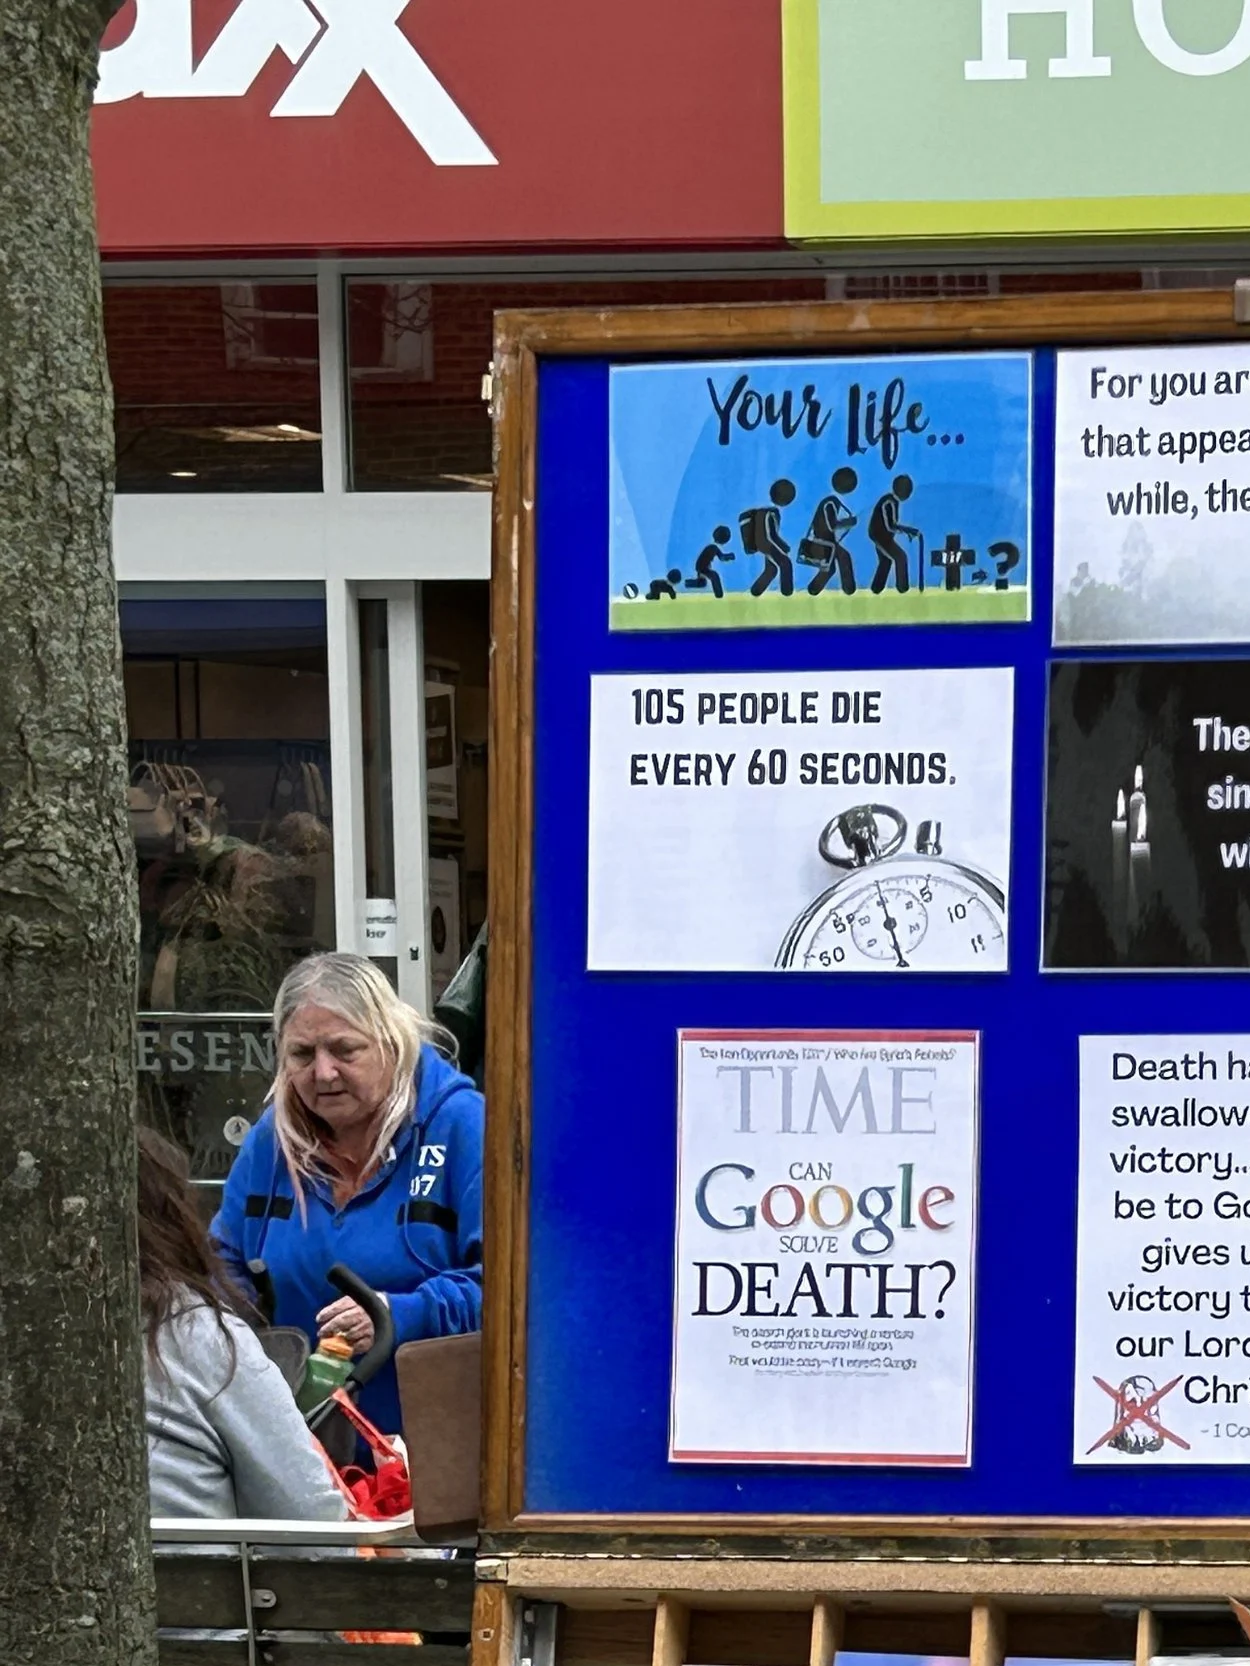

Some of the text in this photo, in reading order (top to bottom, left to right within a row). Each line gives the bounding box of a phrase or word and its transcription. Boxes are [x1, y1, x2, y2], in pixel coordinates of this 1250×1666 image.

[1090, 366, 1143, 399] For
[1150, 368, 1207, 406] you
[706, 373, 966, 470] Your Life...
[1081, 424, 1151, 458] that
[1107, 480, 1198, 519] while,
[632, 688, 882, 726] 105 PEOPLE DIE
[1193, 716, 1250, 752] The
[630, 748, 957, 786] EVERY 60 SECONDS.
[947, 903, 967, 923] 10
[137, 1030, 275, 1073] ESEN
[1112, 1050, 1217, 1081] Death
[715, 1065, 937, 1135] TIME
[788, 1162, 833, 1181] CAN
[694, 1162, 956, 1256] Google
[1115, 1190, 1156, 1219] be
[1165, 1192, 1203, 1219] to
[779, 1235, 838, 1254] SOLVE
[1141, 1237, 1230, 1272] gives
[691, 1260, 957, 1320] DEATH?
[1108, 1283, 1230, 1319] victory
[1115, 1336, 1174, 1358] our
